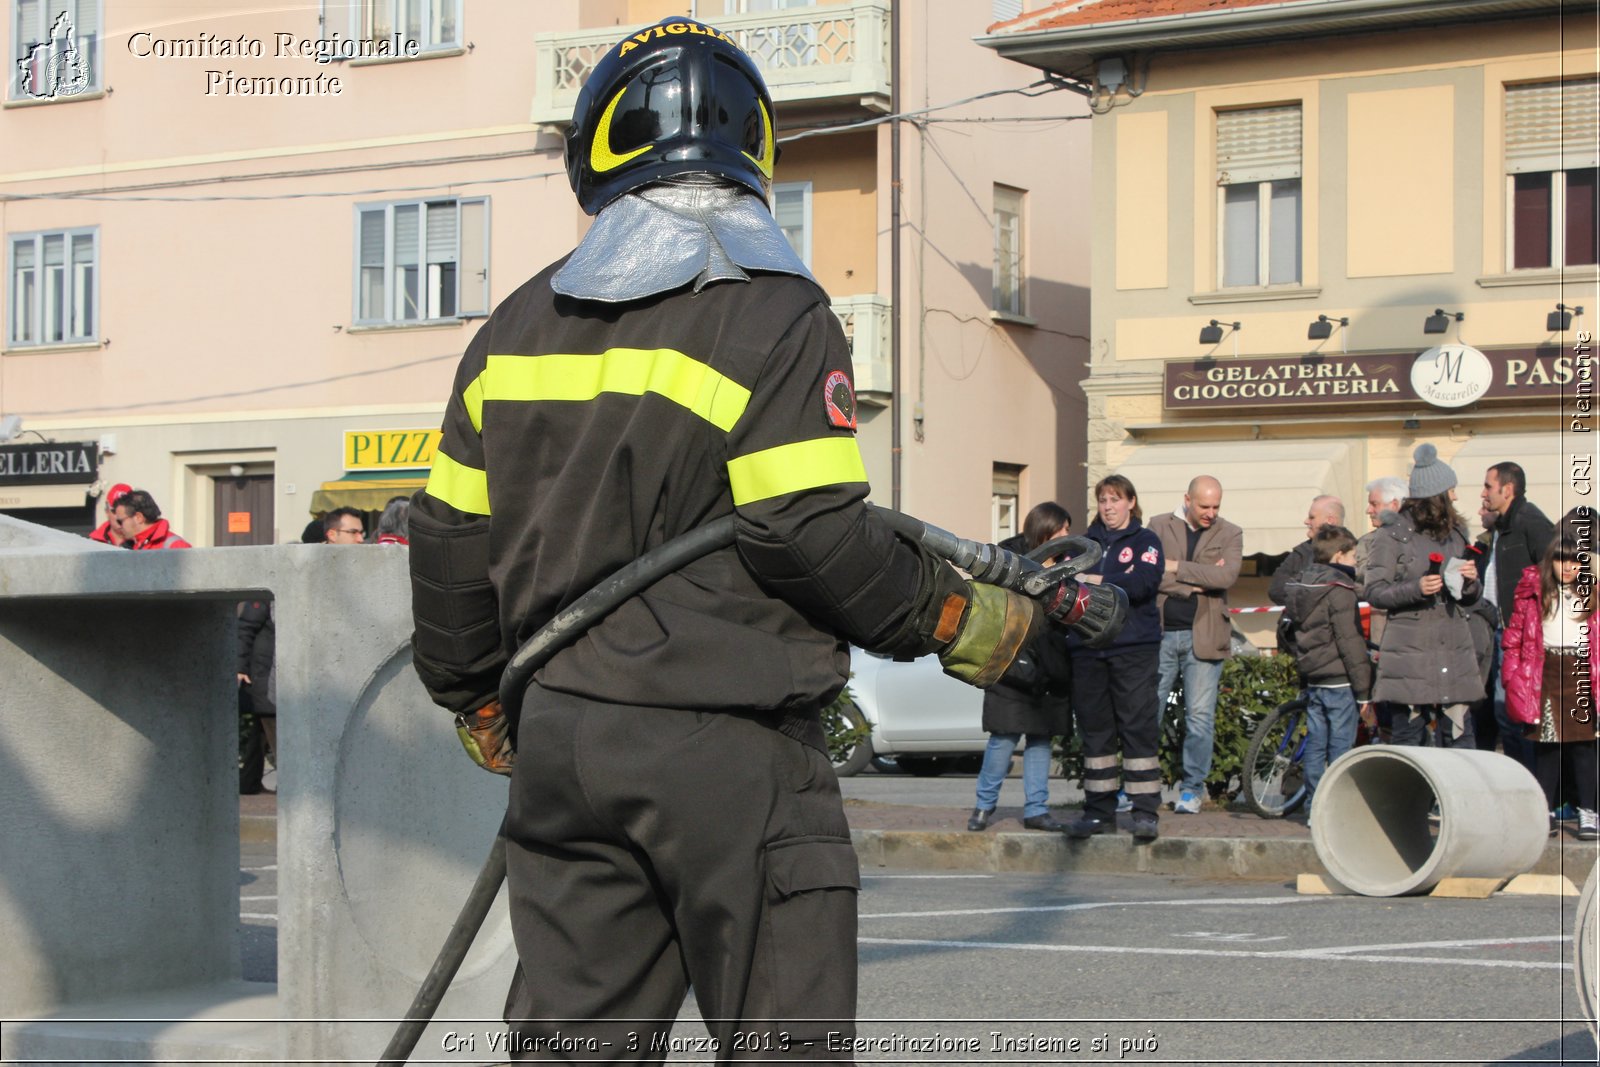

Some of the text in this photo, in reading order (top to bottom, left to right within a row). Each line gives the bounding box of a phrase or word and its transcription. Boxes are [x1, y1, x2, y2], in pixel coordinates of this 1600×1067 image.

[618, 23, 736, 57] AVIGLIA
[1206, 362, 1364, 382] GELATERIA
[1433, 350, 1465, 385] M
[1173, 378, 1400, 400] CIOCCOLATERIA
[1423, 382, 1480, 401] Mascarello
